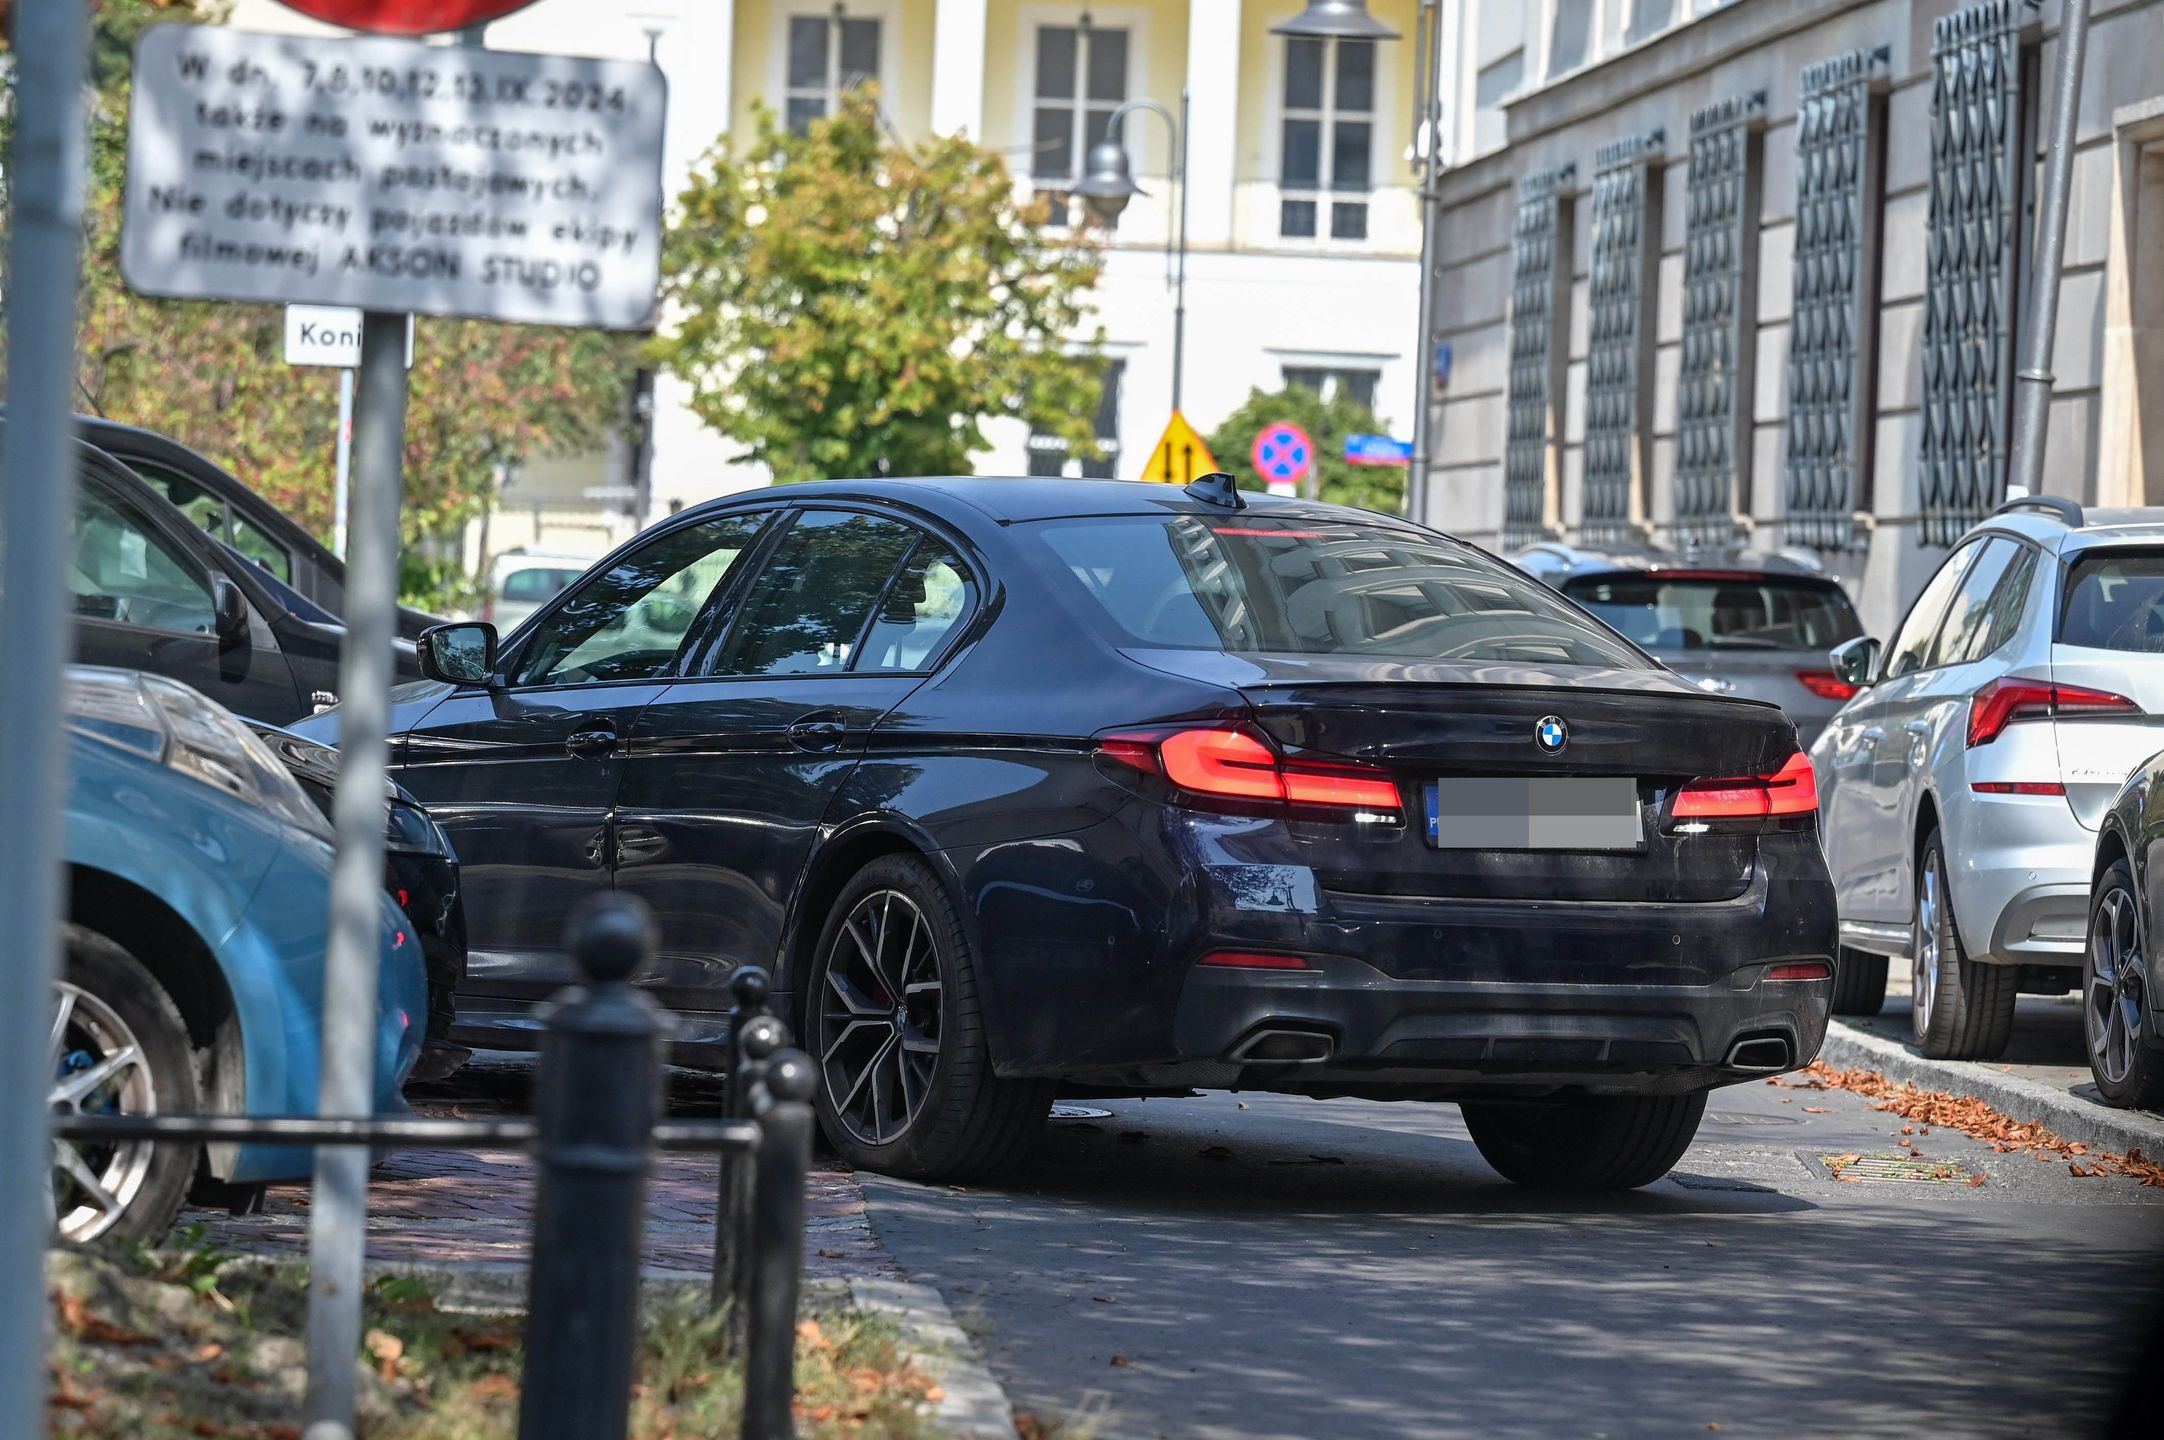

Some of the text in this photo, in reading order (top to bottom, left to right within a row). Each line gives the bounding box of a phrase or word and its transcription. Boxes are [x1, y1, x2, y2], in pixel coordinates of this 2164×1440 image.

[177, 55, 210, 80] W
[304, 112, 348, 136] na
[369, 119, 603, 160] wyznaczonych
[192, 147, 360, 184] miejscach
[149, 184, 206, 217] Nie
[226, 189, 352, 232] dotyczy
[553, 214, 639, 255] ekipy
[180, 230, 602, 292] filmowej AKSON STUDIO
[301, 322, 361, 349] Koni
